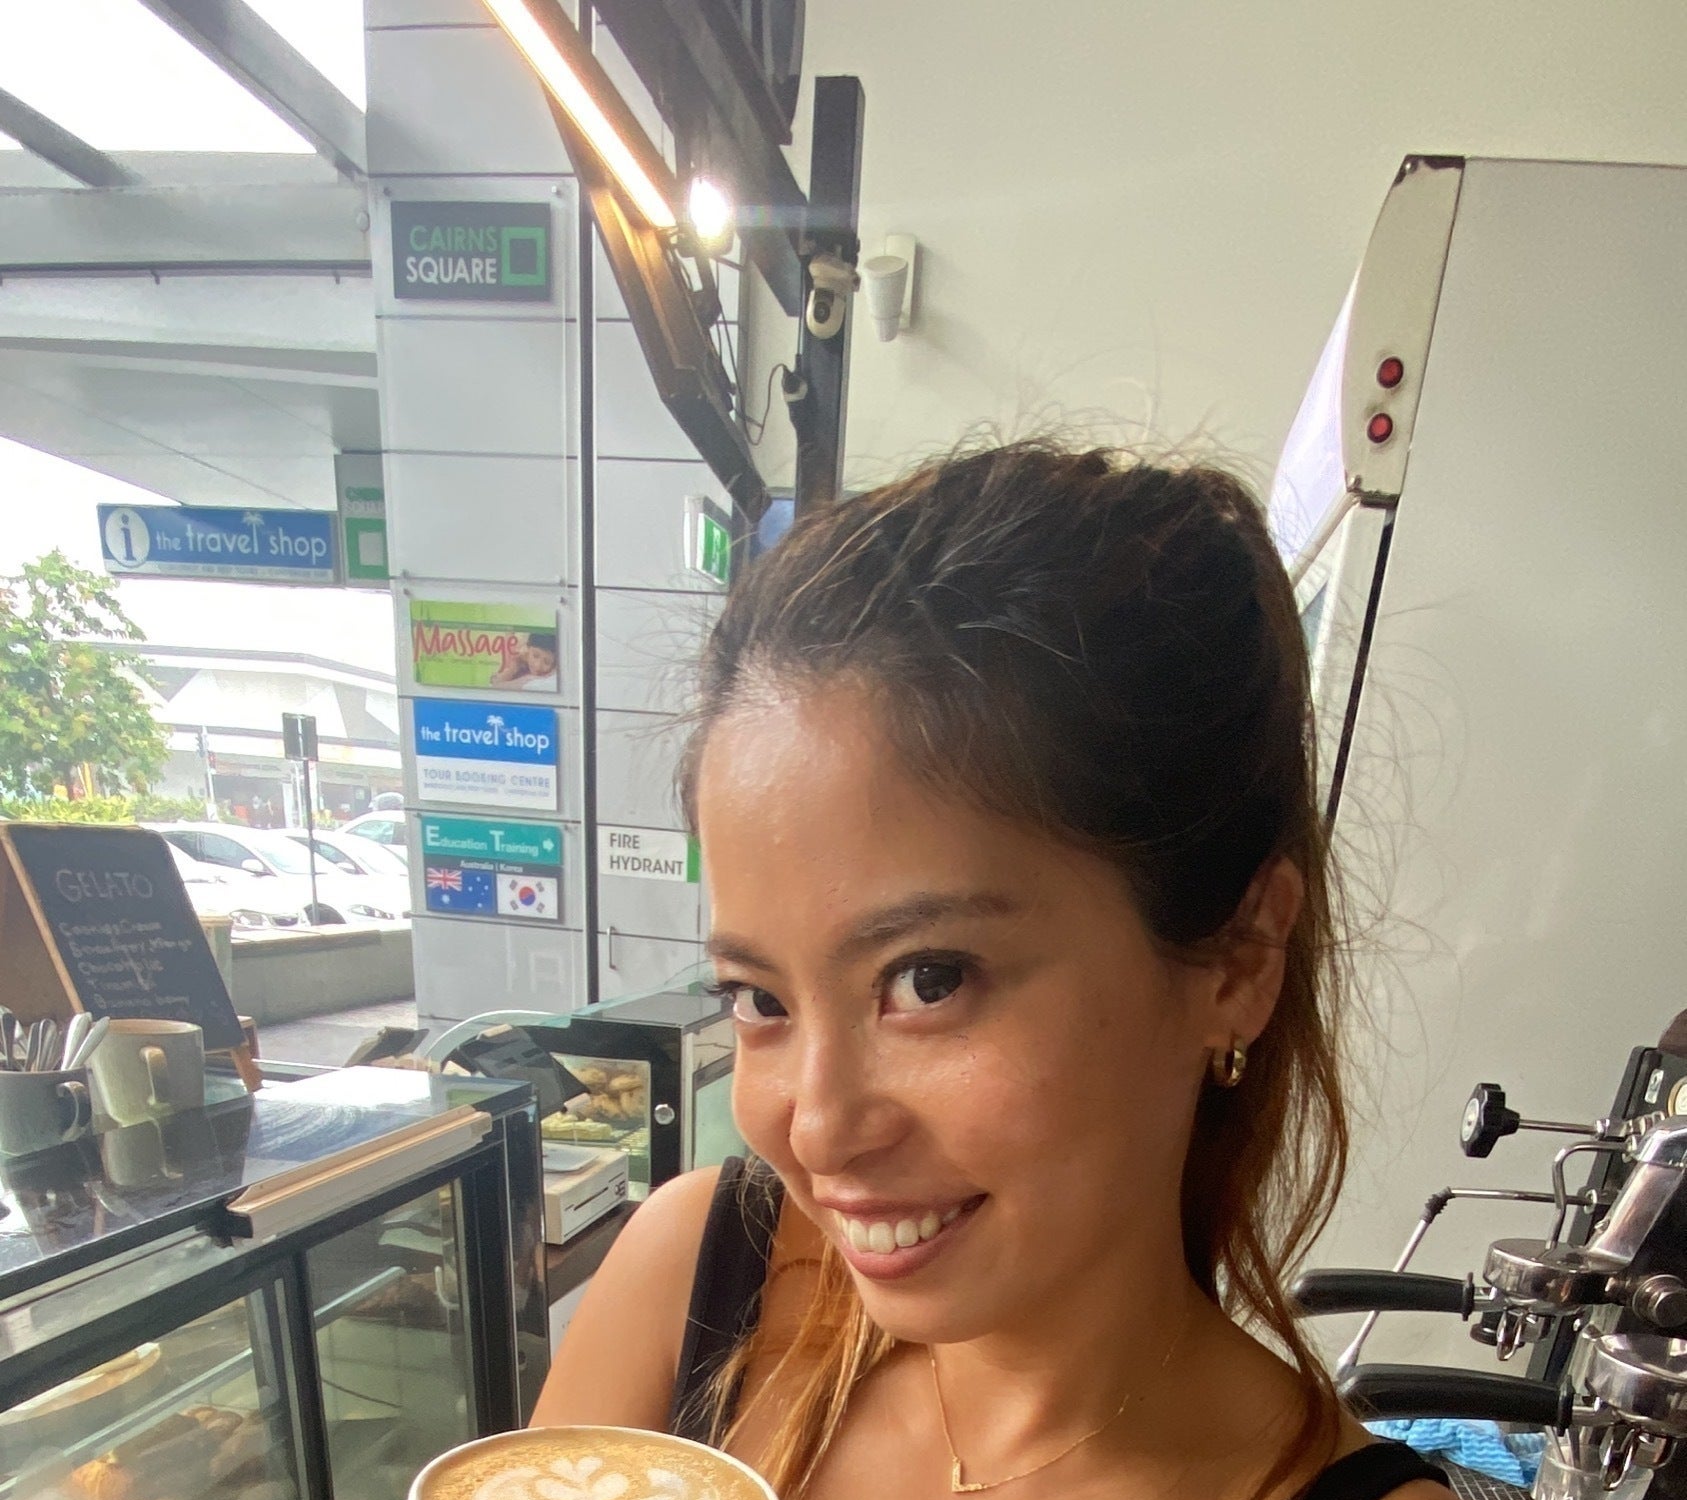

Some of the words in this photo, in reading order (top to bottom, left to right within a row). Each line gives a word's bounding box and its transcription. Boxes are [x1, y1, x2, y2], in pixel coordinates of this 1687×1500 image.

[409, 224, 498, 252] CAIRNS
[406, 256, 497, 284] SQUARE
[156, 527, 182, 551] the
[186, 521, 260, 554] travel
[269, 527, 327, 565] shop
[414, 620, 520, 673] Massage
[421, 726, 441, 741] the
[444, 721, 499, 746] travel
[505, 727, 550, 755] shop
[424, 768, 451, 780] TOUR
[455, 770, 506, 785] BOOKING
[510, 775, 550, 789] CENTRE
[426, 825, 488, 850] Education
[489, 830, 539, 857] Training
[609, 833, 640, 849] FIRE
[460, 860, 494, 870] Australia
[500, 863, 523, 873] Korea
[610, 855, 684, 875] HYDRANT
[56, 869, 153, 902] GELATO
